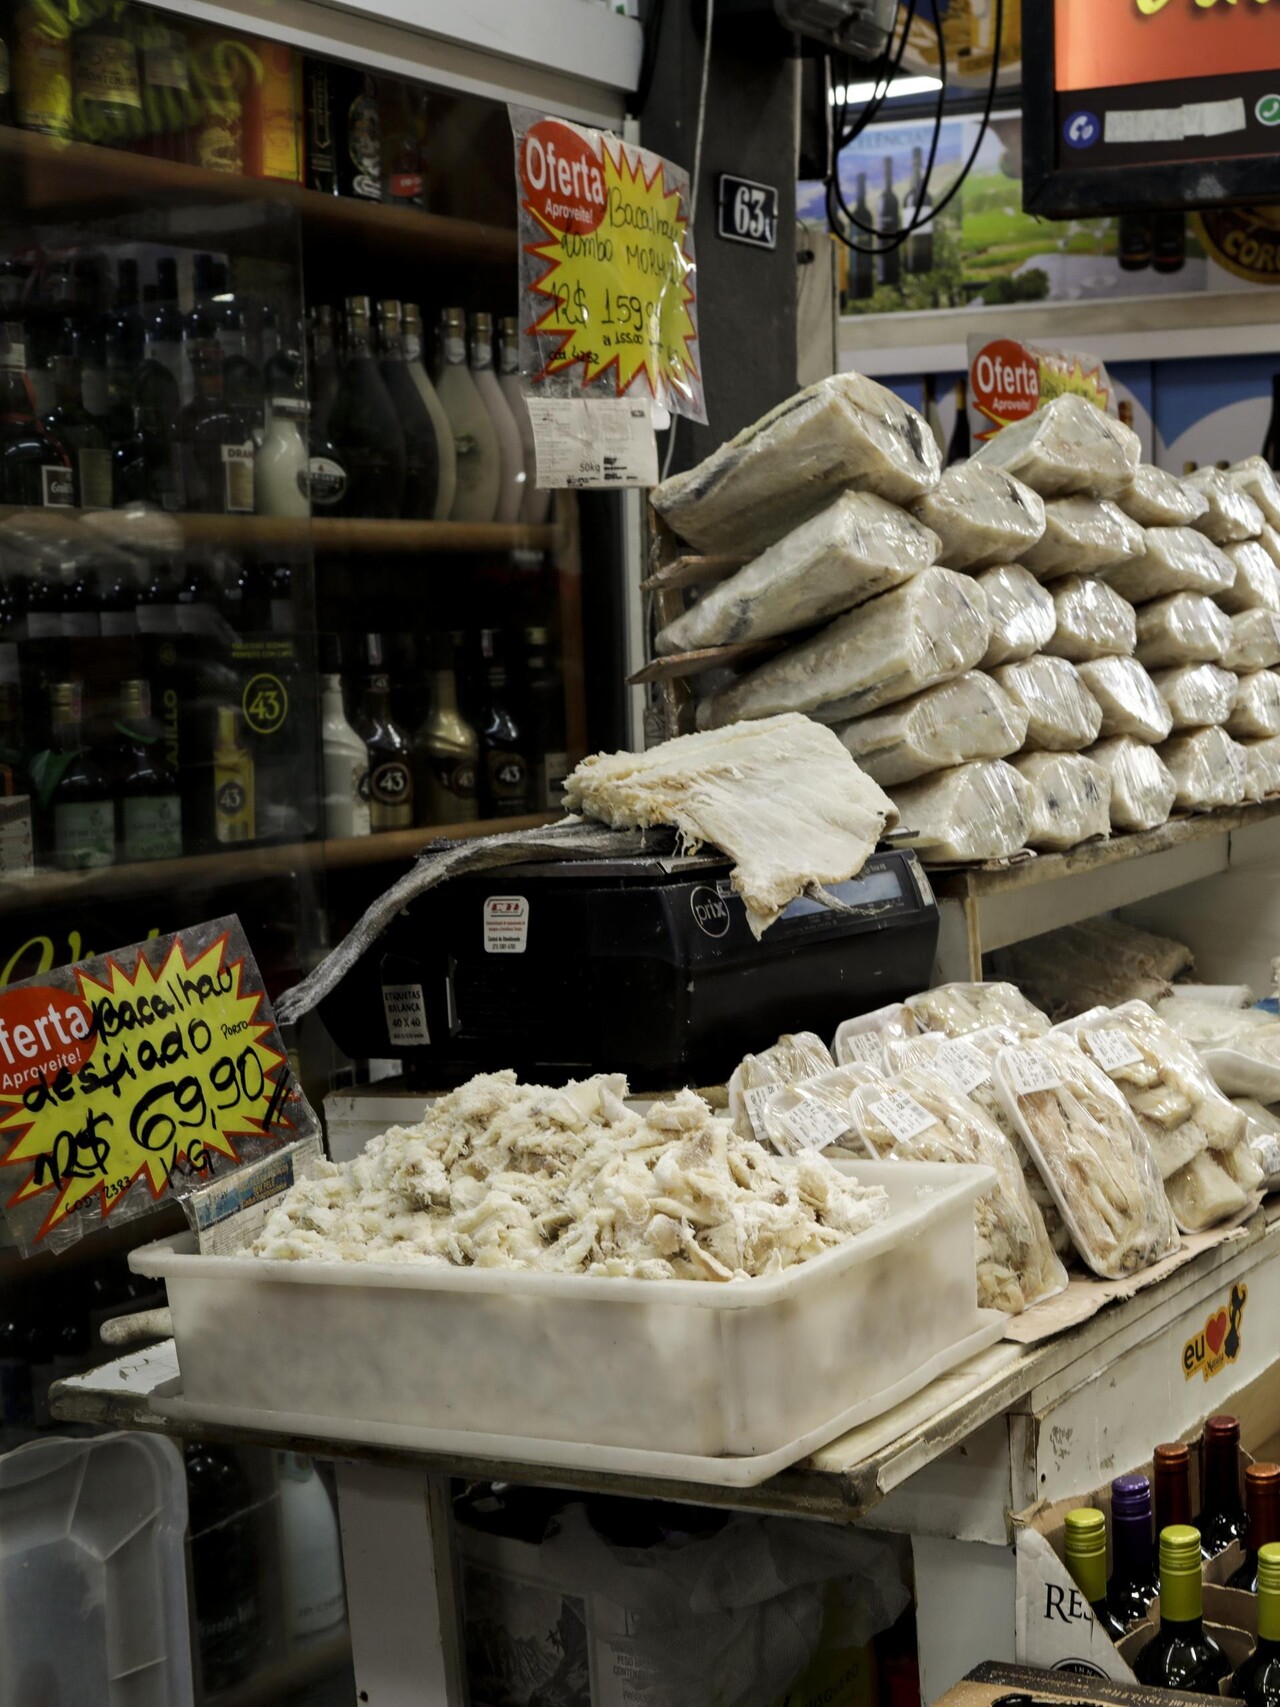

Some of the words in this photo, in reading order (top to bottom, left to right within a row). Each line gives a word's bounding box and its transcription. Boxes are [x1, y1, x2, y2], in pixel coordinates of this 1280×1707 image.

[526, 137, 604, 205] Oferta
[545, 198, 593, 224] Aproveite!
[734, 186, 766, 238] 63
[977, 355, 1039, 396] Oferta
[249, 691, 280, 720] 43
[379, 772, 405, 791] 43
[500, 766, 521, 783] 43
[219, 789, 241, 808] 43
[695, 898, 727, 925] prix
[90, 965, 233, 1046] Bacalhau
[385, 991, 420, 1001] ETIQUETAS
[0, 1002, 91, 1066] ferta
[22, 1017, 211, 1113] desfiado
[33, 1107, 113, 1191] R$
[129, 1046, 265, 1151] 69,90
[1184, 1334, 1205, 1369] eu
